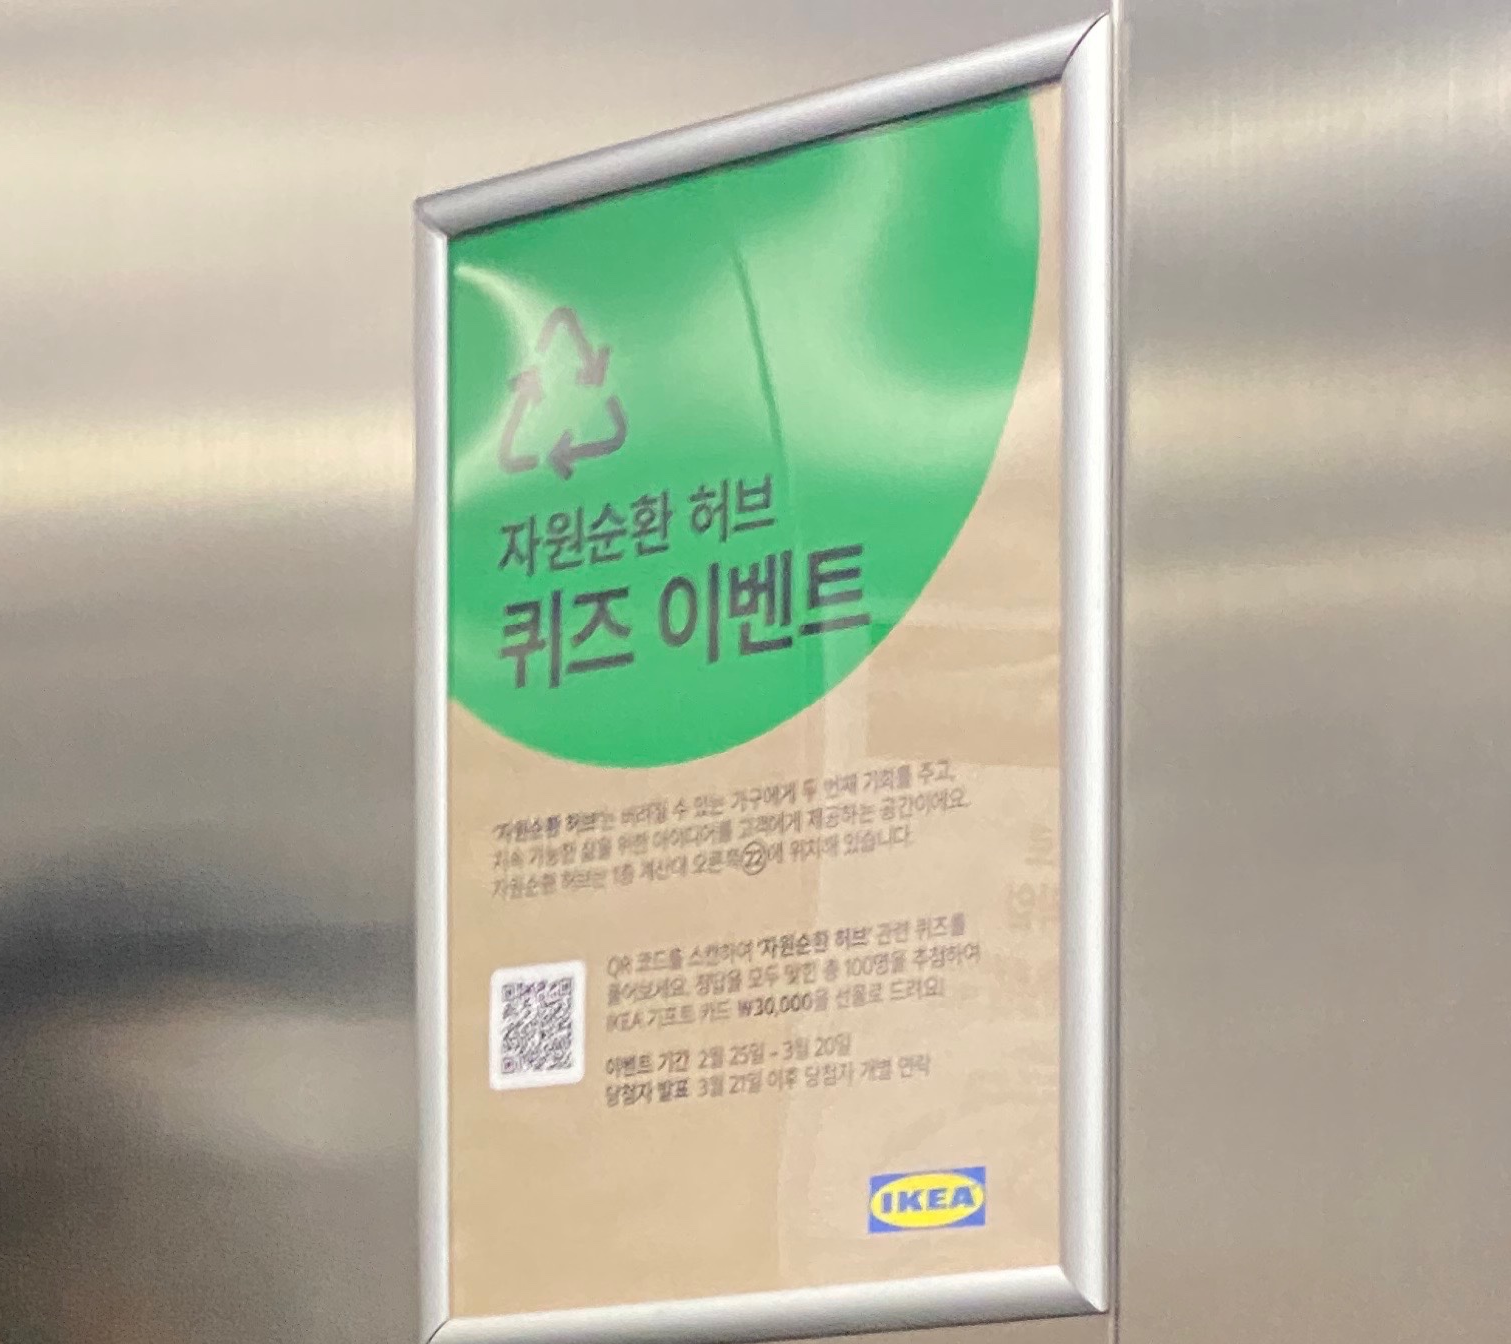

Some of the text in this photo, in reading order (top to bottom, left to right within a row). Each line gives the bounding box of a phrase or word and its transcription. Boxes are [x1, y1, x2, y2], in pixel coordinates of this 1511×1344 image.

[498, 473, 777, 579] 자원순환 허브
[499, 543, 872, 690] 퀴즈 이벤트
[730, 781, 796, 812] 가구에게
[863, 765, 910, 794] 기회를
[652, 819, 732, 848] 아이디어를
[739, 810, 801, 838] 고객에게
[808, 803, 875, 828] 제공하는
[639, 854, 687, 881] 계산대
[789, 834, 839, 862] 위치해
[607, 955, 633, 979] QR
[635, 947, 682, 972] 코드를
[688, 939, 753, 966] 스캔하여
[877, 920, 910, 946] 관련
[915, 912, 965, 940] 퀴즈를
[748, 964, 780, 988] 모두
[913, 943, 981, 969] 추첨하여
[606, 1011, 641, 1032] IKEA
[647, 1005, 696, 1026] 기프트
[700, 1000, 732, 1023] 카드
[837, 982, 884, 1009] 선물로
[605, 1053, 653, 1077] 이벤트
[658, 1049, 689, 1073] 기간
[698, 1045, 724, 1069] 2월
[729, 1041, 765, 1066] 25일
[782, 1036, 811, 1061] 3월
[814, 1032, 852, 1057] 20일
[605, 1080, 653, 1108] 당첨자
[657, 1078, 689, 1103] 발표
[697, 1074, 724, 1098] 3월
[767, 1066, 798, 1090] 이후
[804, 1061, 854, 1088] 당첨자
[860, 1057, 891, 1081] 개별
[898, 1053, 931, 1079] 연락
[880, 1185, 976, 1214] IKEA
